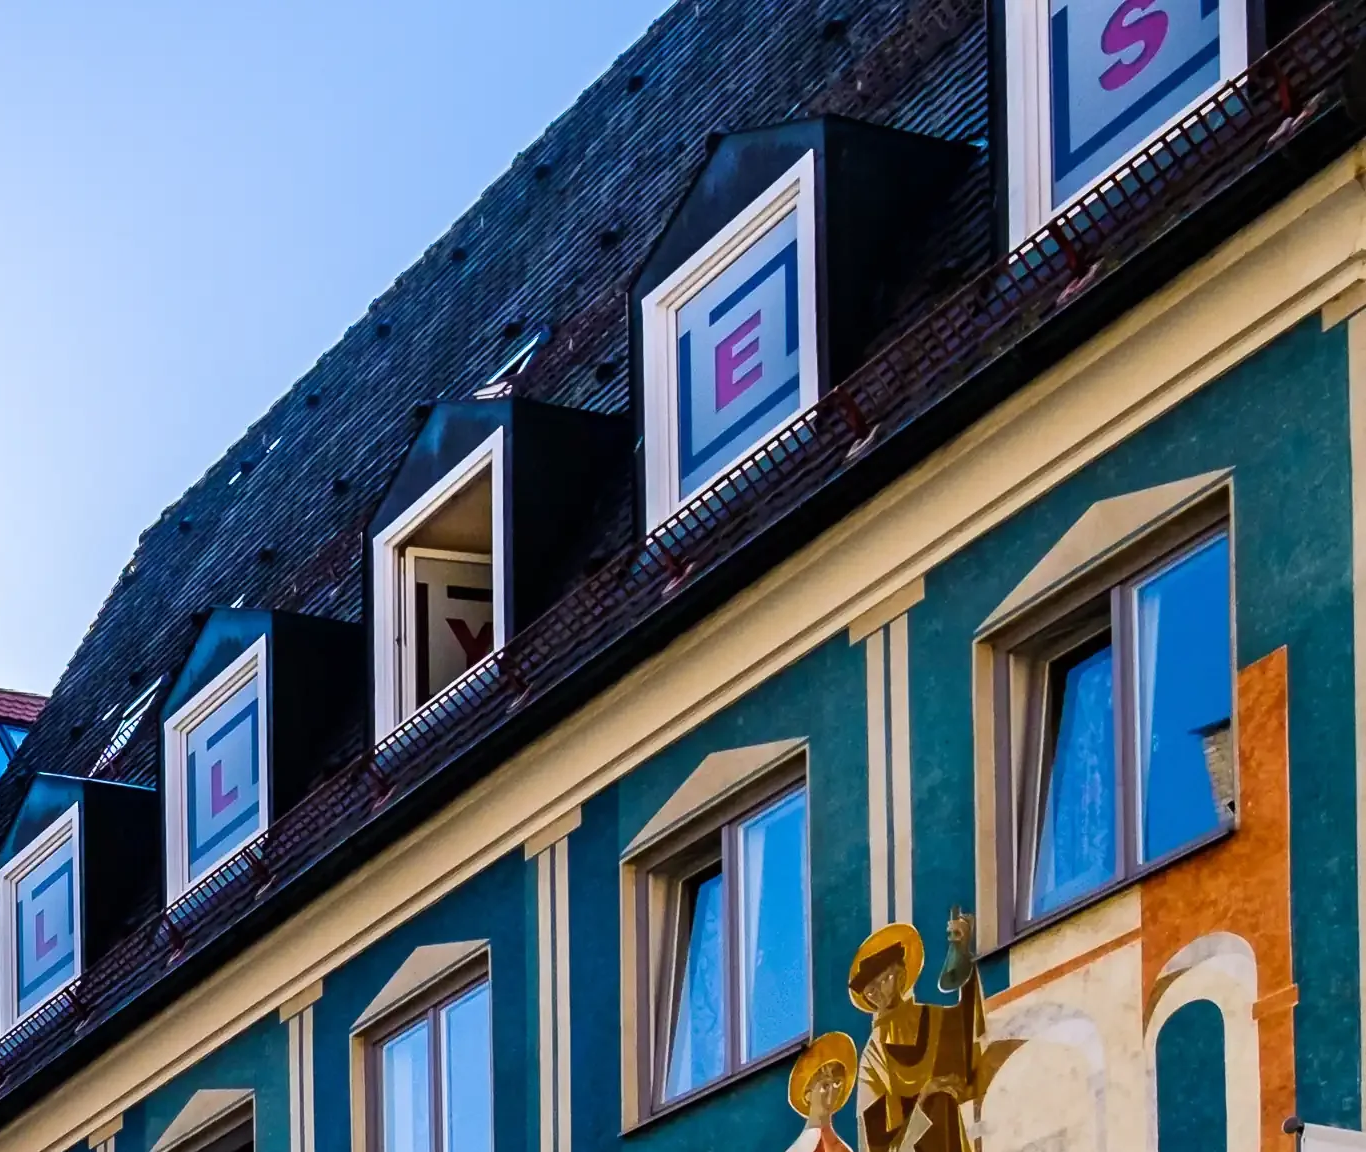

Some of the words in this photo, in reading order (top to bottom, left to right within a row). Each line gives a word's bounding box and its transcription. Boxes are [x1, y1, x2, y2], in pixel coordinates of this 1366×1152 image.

[35, 909, 58, 961] L
[211, 760, 239, 819] L
[715, 309, 763, 412] E
[1098, 0, 1169, 92] S
